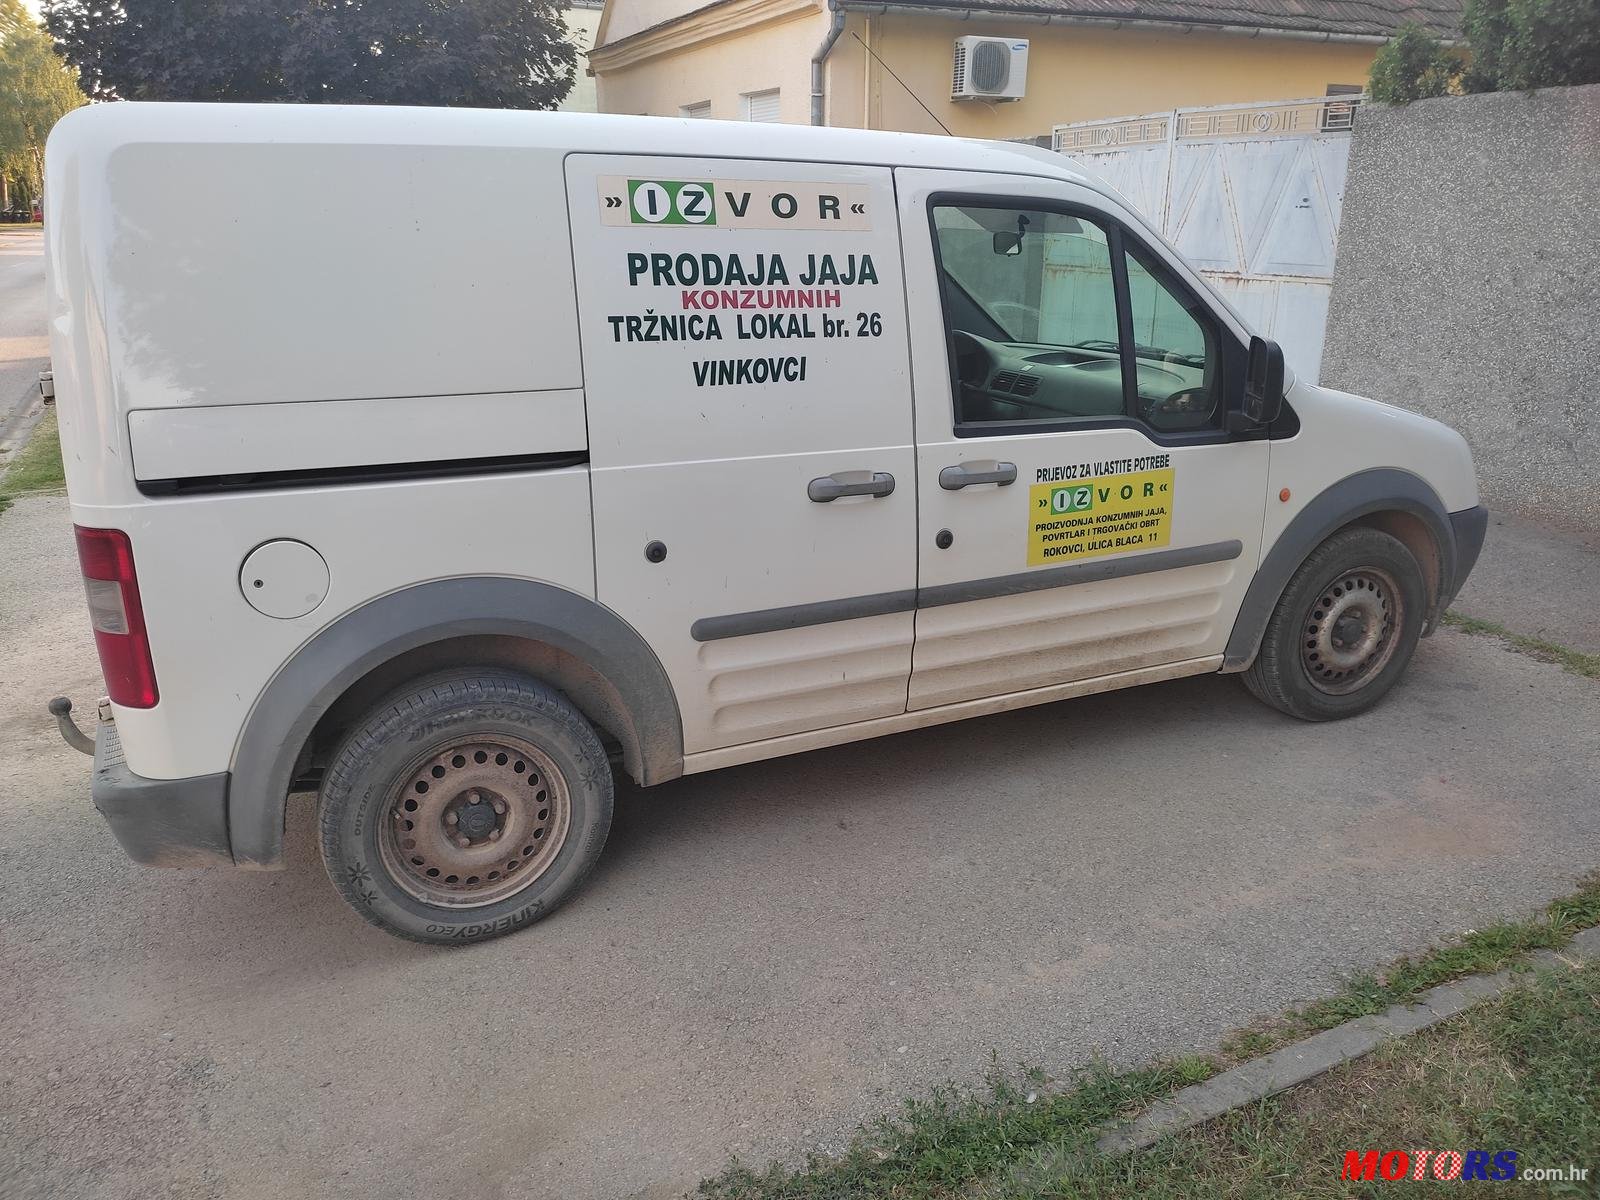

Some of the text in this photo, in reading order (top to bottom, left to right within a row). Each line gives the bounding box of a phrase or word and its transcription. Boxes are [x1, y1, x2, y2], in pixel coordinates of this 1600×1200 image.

[627, 252, 879, 286] PRODAJA JAJA
[681, 289, 841, 310] KONZUMNIH
[608, 309, 883, 342] TRŽNICA LOKAL br. 26
[692, 356, 807, 387] VINKOVCI
[1036, 454, 1170, 483] PRIJEVOZ ZA VLASTITE POTREBE
[1035, 507, 1168, 532] PROIZVODNJA KONZUMNIH JAJA,
[1042, 518, 1160, 542] POVRTLAR I TRGOVAČKI OBRT
[1043, 532, 1157, 557] ROKOVCI, ULICA BLACA 11
